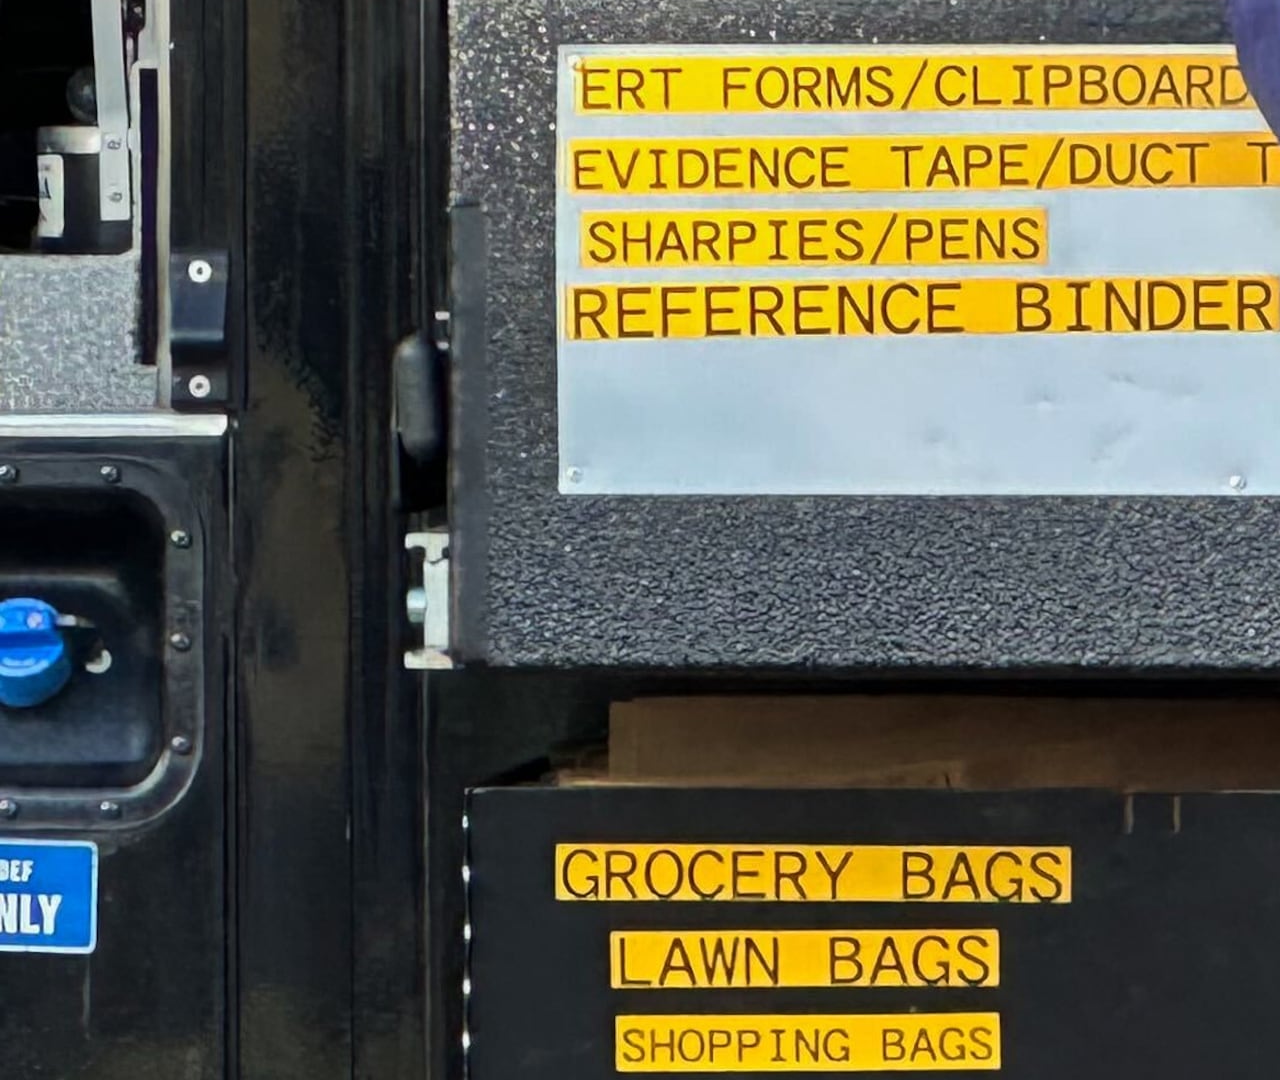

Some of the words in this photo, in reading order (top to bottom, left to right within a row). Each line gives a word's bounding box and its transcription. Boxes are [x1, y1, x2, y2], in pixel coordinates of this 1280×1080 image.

[582, 68, 682, 109] ERT
[574, 146, 850, 189] EVIDENCE
[898, 137, 1210, 189] TAPE/DUCT
[588, 212, 1040, 263] SHARPIES/PENS
[573, 284, 964, 338] REFERENCE
[1015, 278, 1274, 332] BINDER
[562, 849, 853, 899] GROCERY
[902, 851, 1063, 901] BAGS
[0, 893, 63, 935] NLY
[619, 937, 780, 985] LAWN
[829, 935, 990, 985] BAGS
[622, 1028, 850, 1063] SHOPPING
[881, 1026, 993, 1063] BAGS
